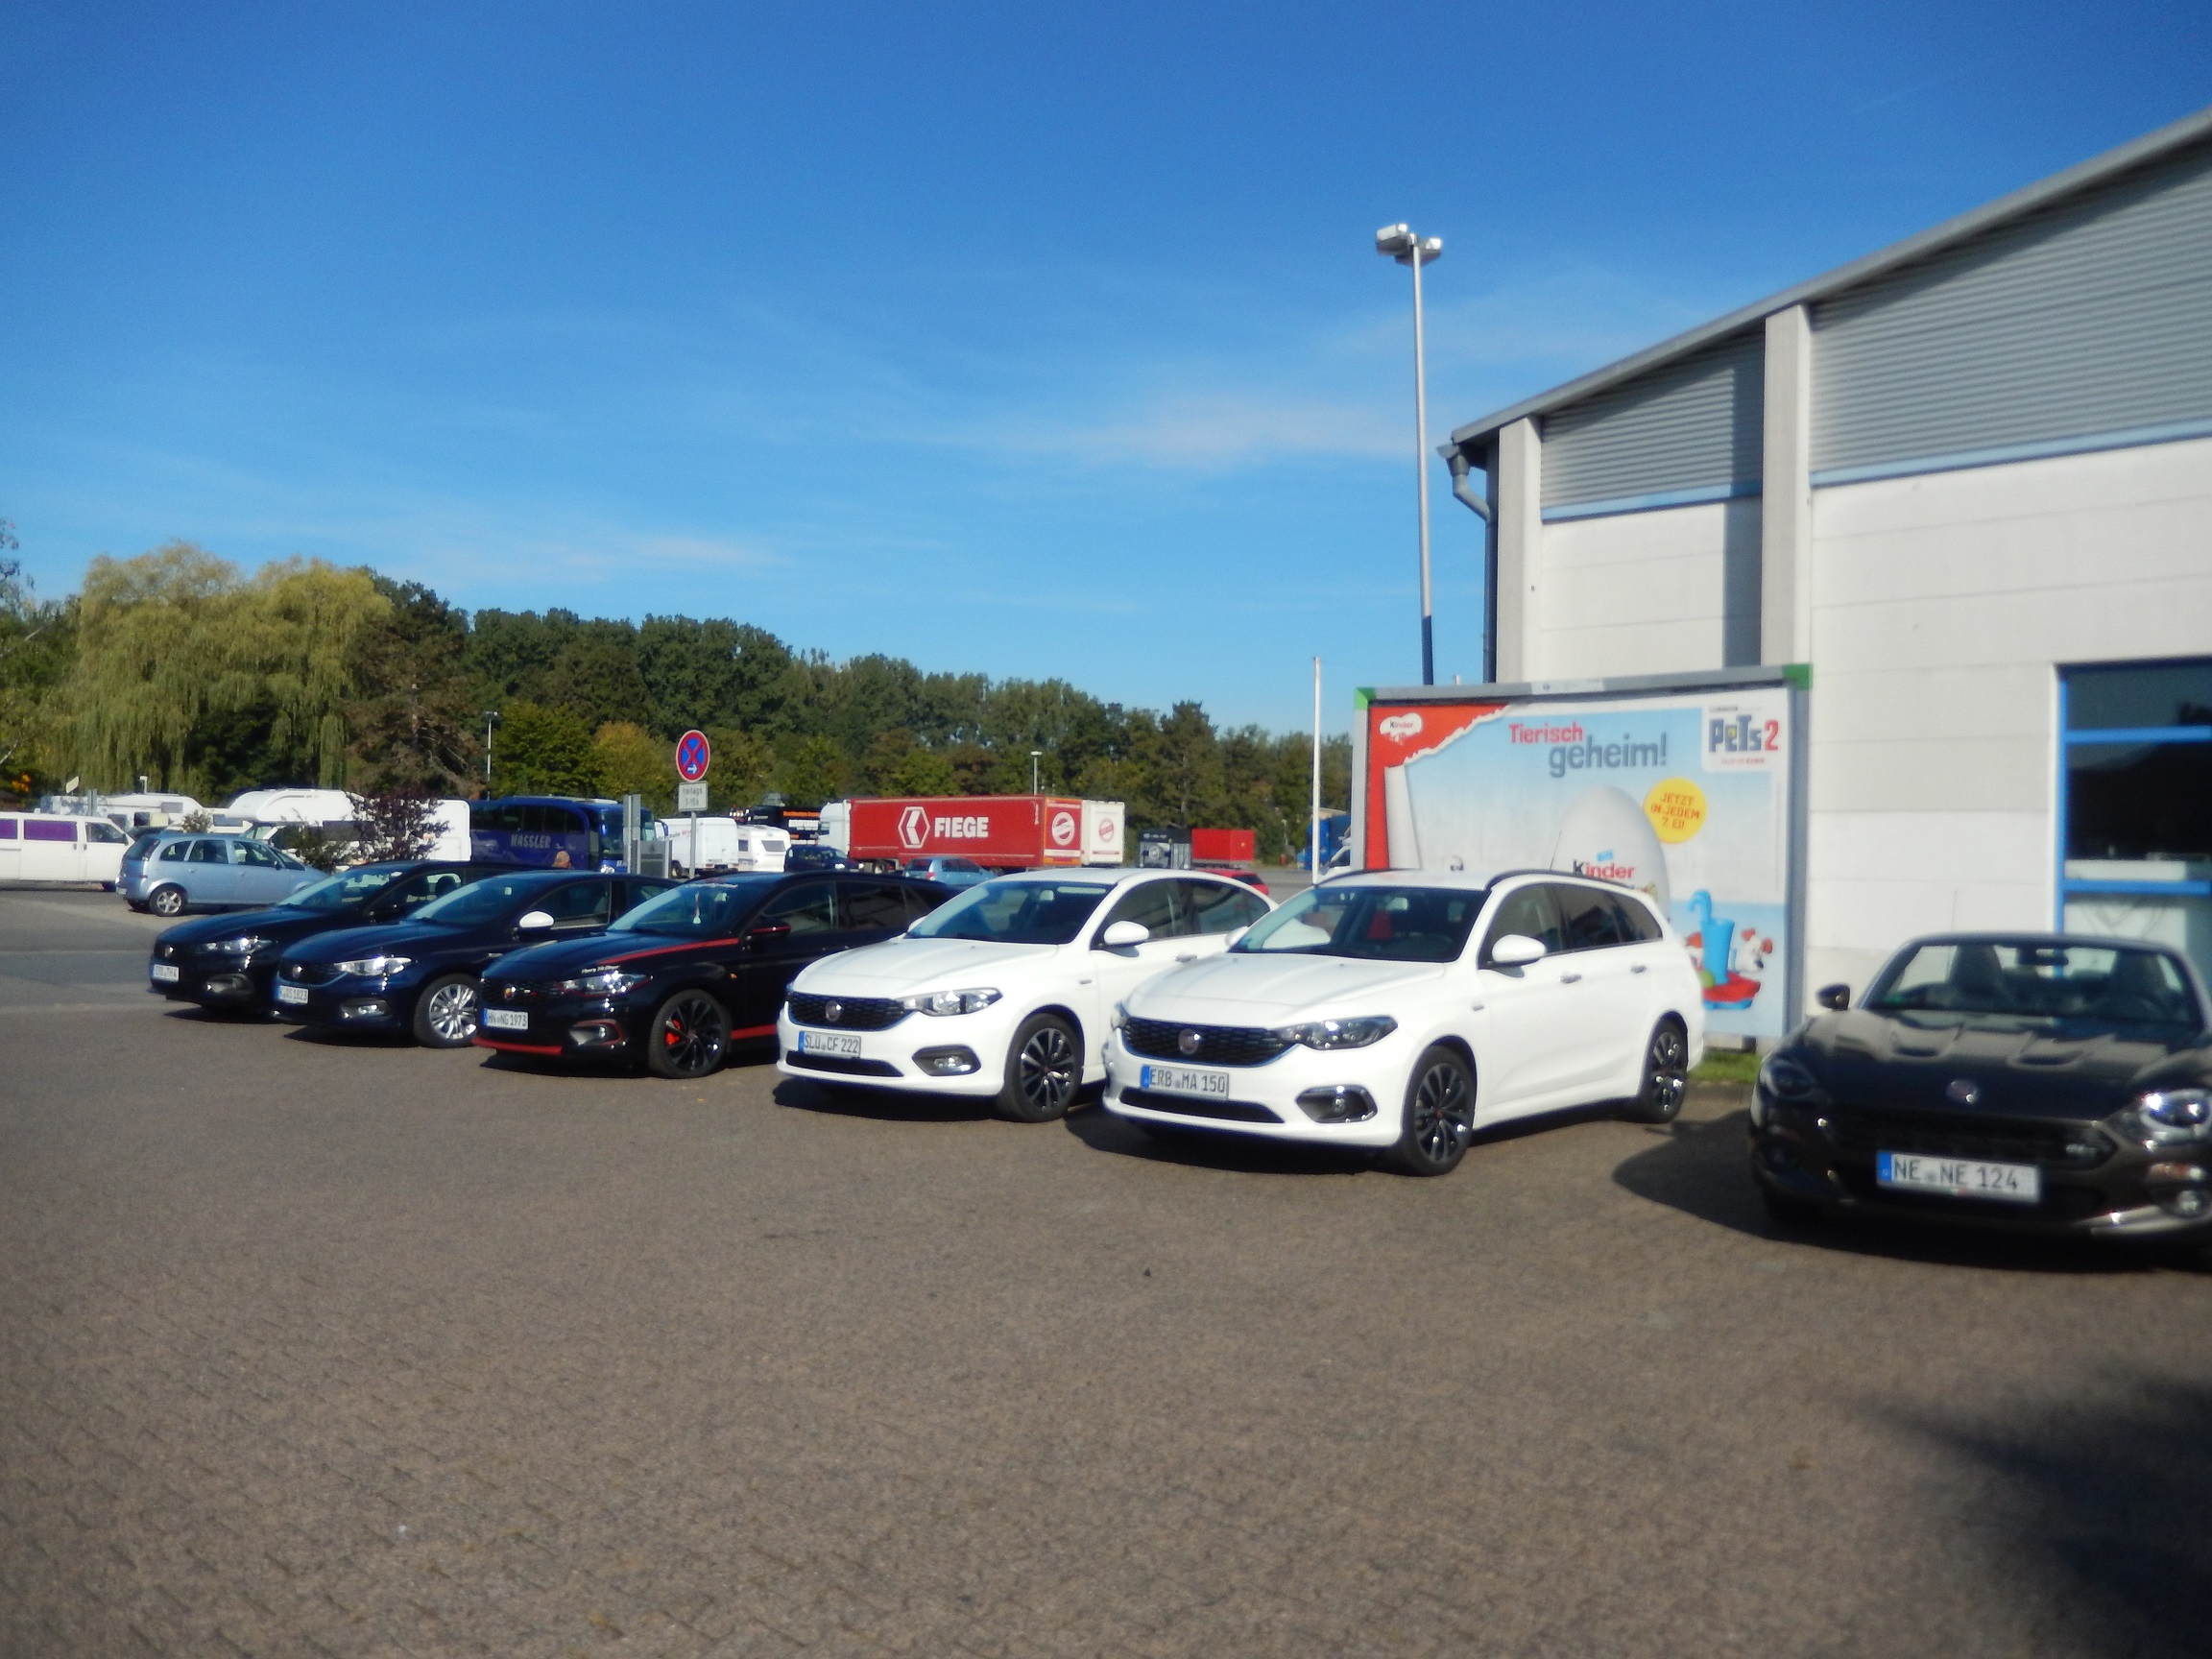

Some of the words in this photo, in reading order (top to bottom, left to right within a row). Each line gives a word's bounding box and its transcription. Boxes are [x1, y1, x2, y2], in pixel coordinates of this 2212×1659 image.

[1508, 721, 1583, 744] Tierisch
[1765, 720, 1779, 751] 2
[1549, 733, 1667, 778] geheim!
[1660, 793, 1695, 806] JETZT
[933, 816, 989, 838] FIEGE
[827, 1036, 839, 1051] CF
[840, 1038, 859, 1054] 222
[1149, 1068, 1172, 1088] ERB
[1181, 1072, 1197, 1091] MA
[1201, 1074, 1226, 1094] 150
[1892, 1157, 1921, 1181] NE
[1939, 1162, 1968, 1185] NE
[1976, 1166, 2018, 1190] 124
